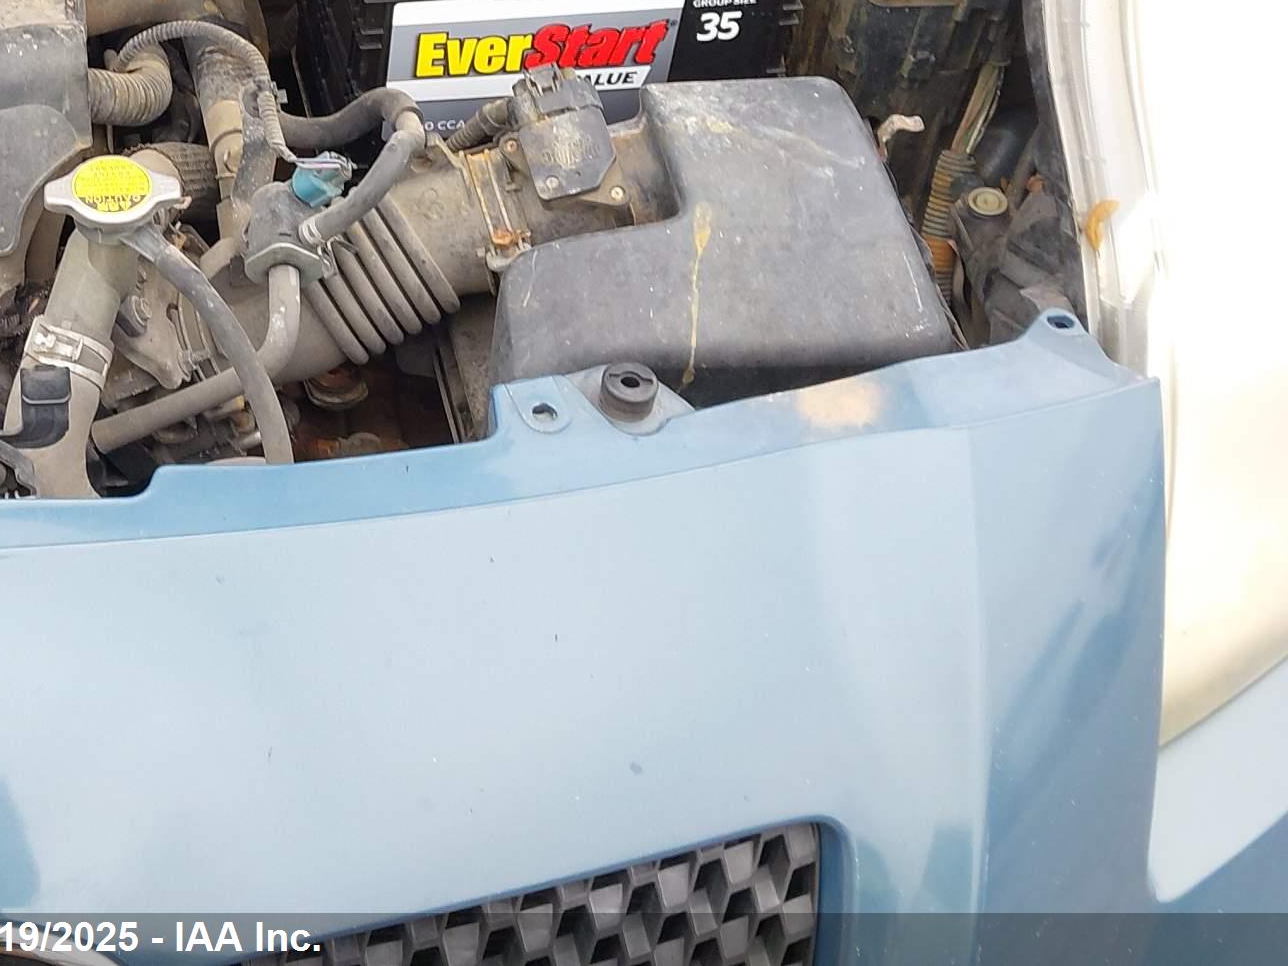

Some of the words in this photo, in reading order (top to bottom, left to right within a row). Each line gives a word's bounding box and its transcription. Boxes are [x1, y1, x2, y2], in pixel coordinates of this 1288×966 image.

[696, 11, 743, 42] 35
[414, 18, 670, 79] EverStart
[577, 71, 638, 86] ALUE
